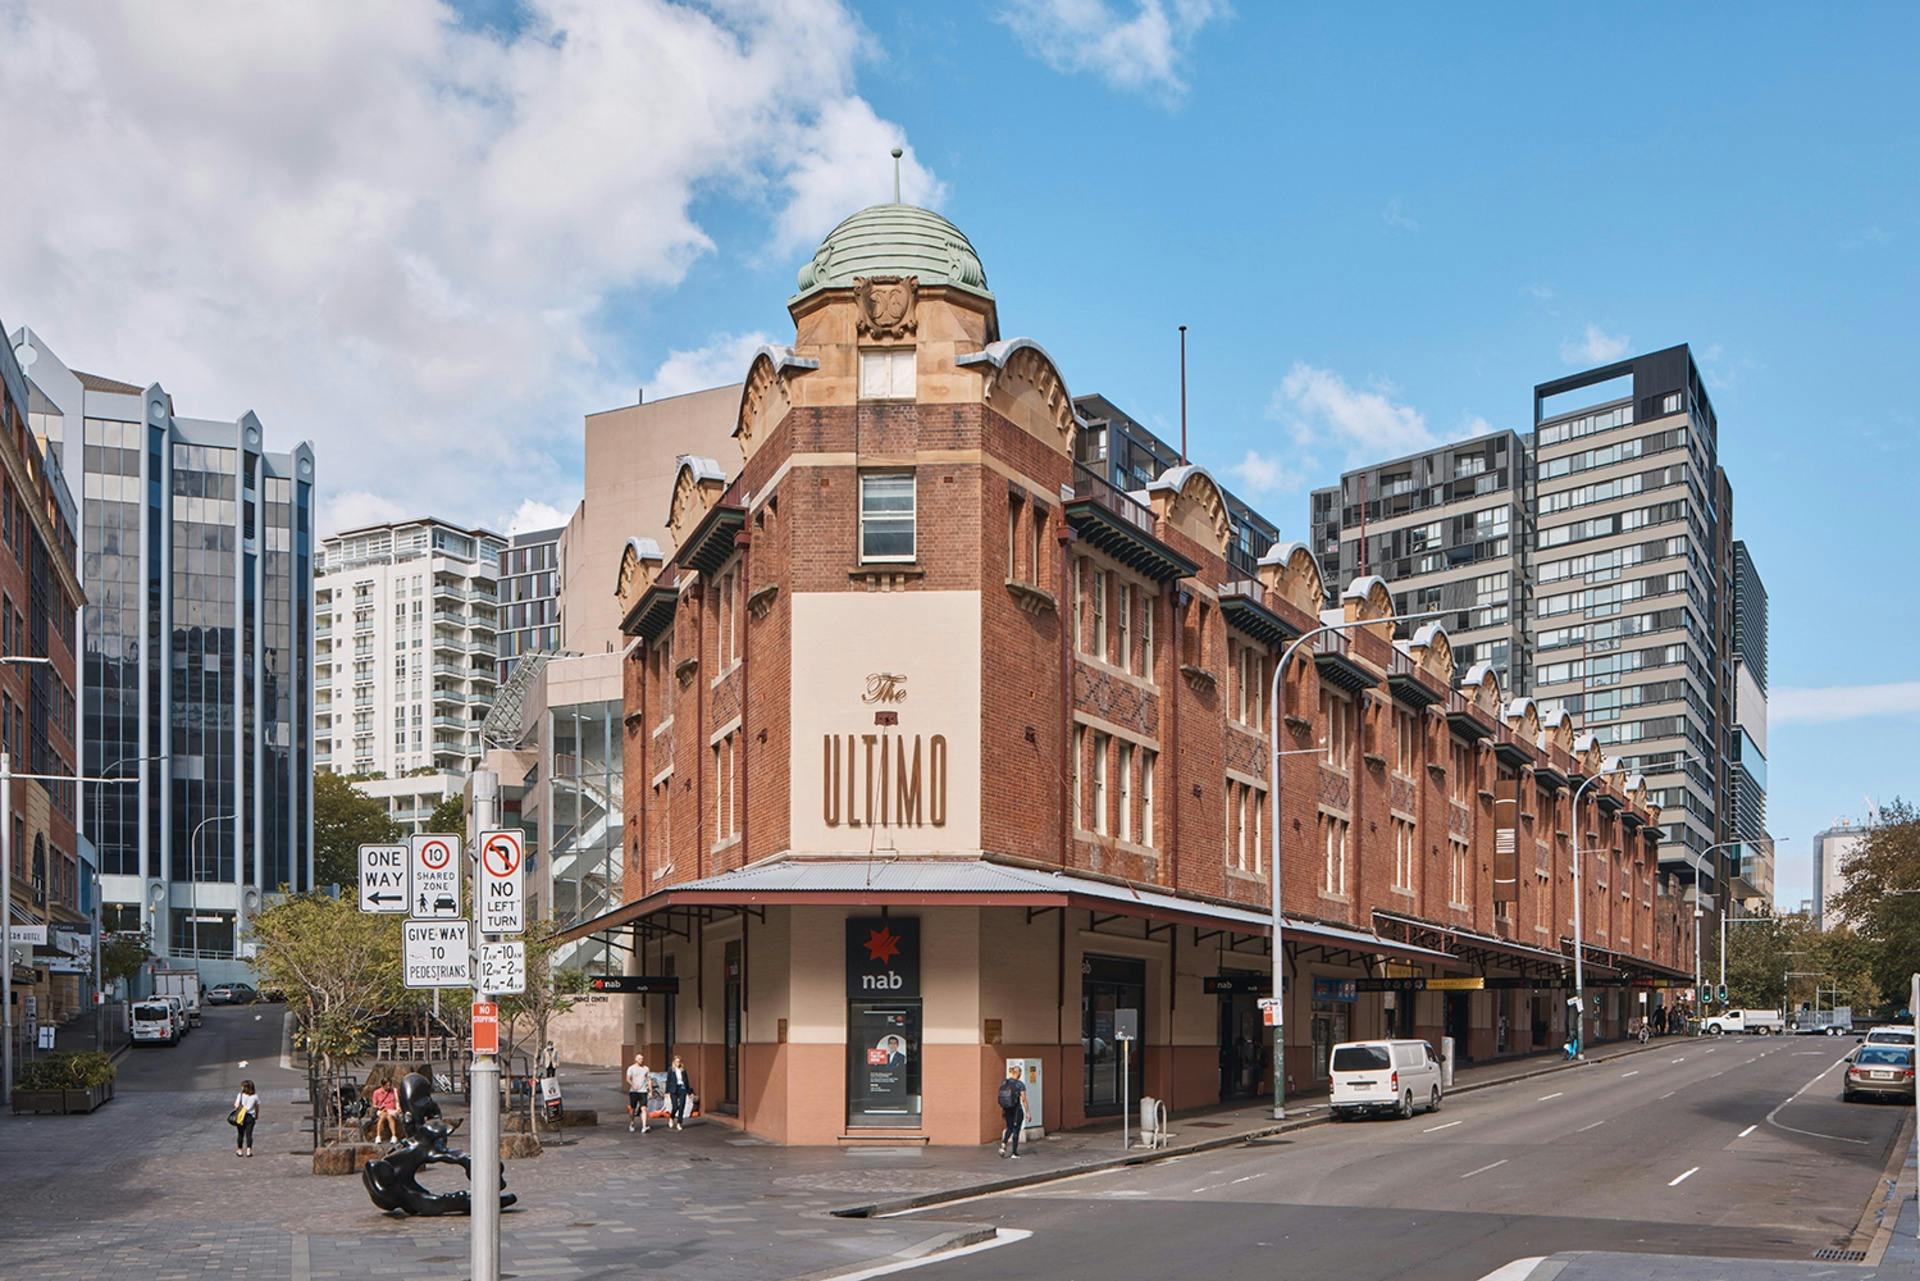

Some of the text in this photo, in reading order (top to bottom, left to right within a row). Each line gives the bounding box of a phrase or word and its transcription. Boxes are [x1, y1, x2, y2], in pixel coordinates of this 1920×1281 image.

[862, 672, 907, 704] The
[824, 734, 947, 828] ULTIMO
[368, 852, 401, 867] ONE
[429, 849, 442, 861] 10
[365, 873, 403, 887] WAY
[416, 872, 455, 880] SHARED
[423, 882, 449, 891] ZONE
[490, 882, 513, 897] NO
[488, 901, 515, 912] LEFT
[488, 916, 517, 927] TURN
[408, 928, 465, 941] GIVE WAY
[430, 947, 445, 959] TO
[410, 965, 466, 979] PEDESTRIANS
[1081, 960, 1092, 974] ab
[604, 979, 621, 988] nab
[862, 971, 903, 990] nab
[1217, 981, 1232, 989] nab
[479, 1006, 490, 1014] NO
